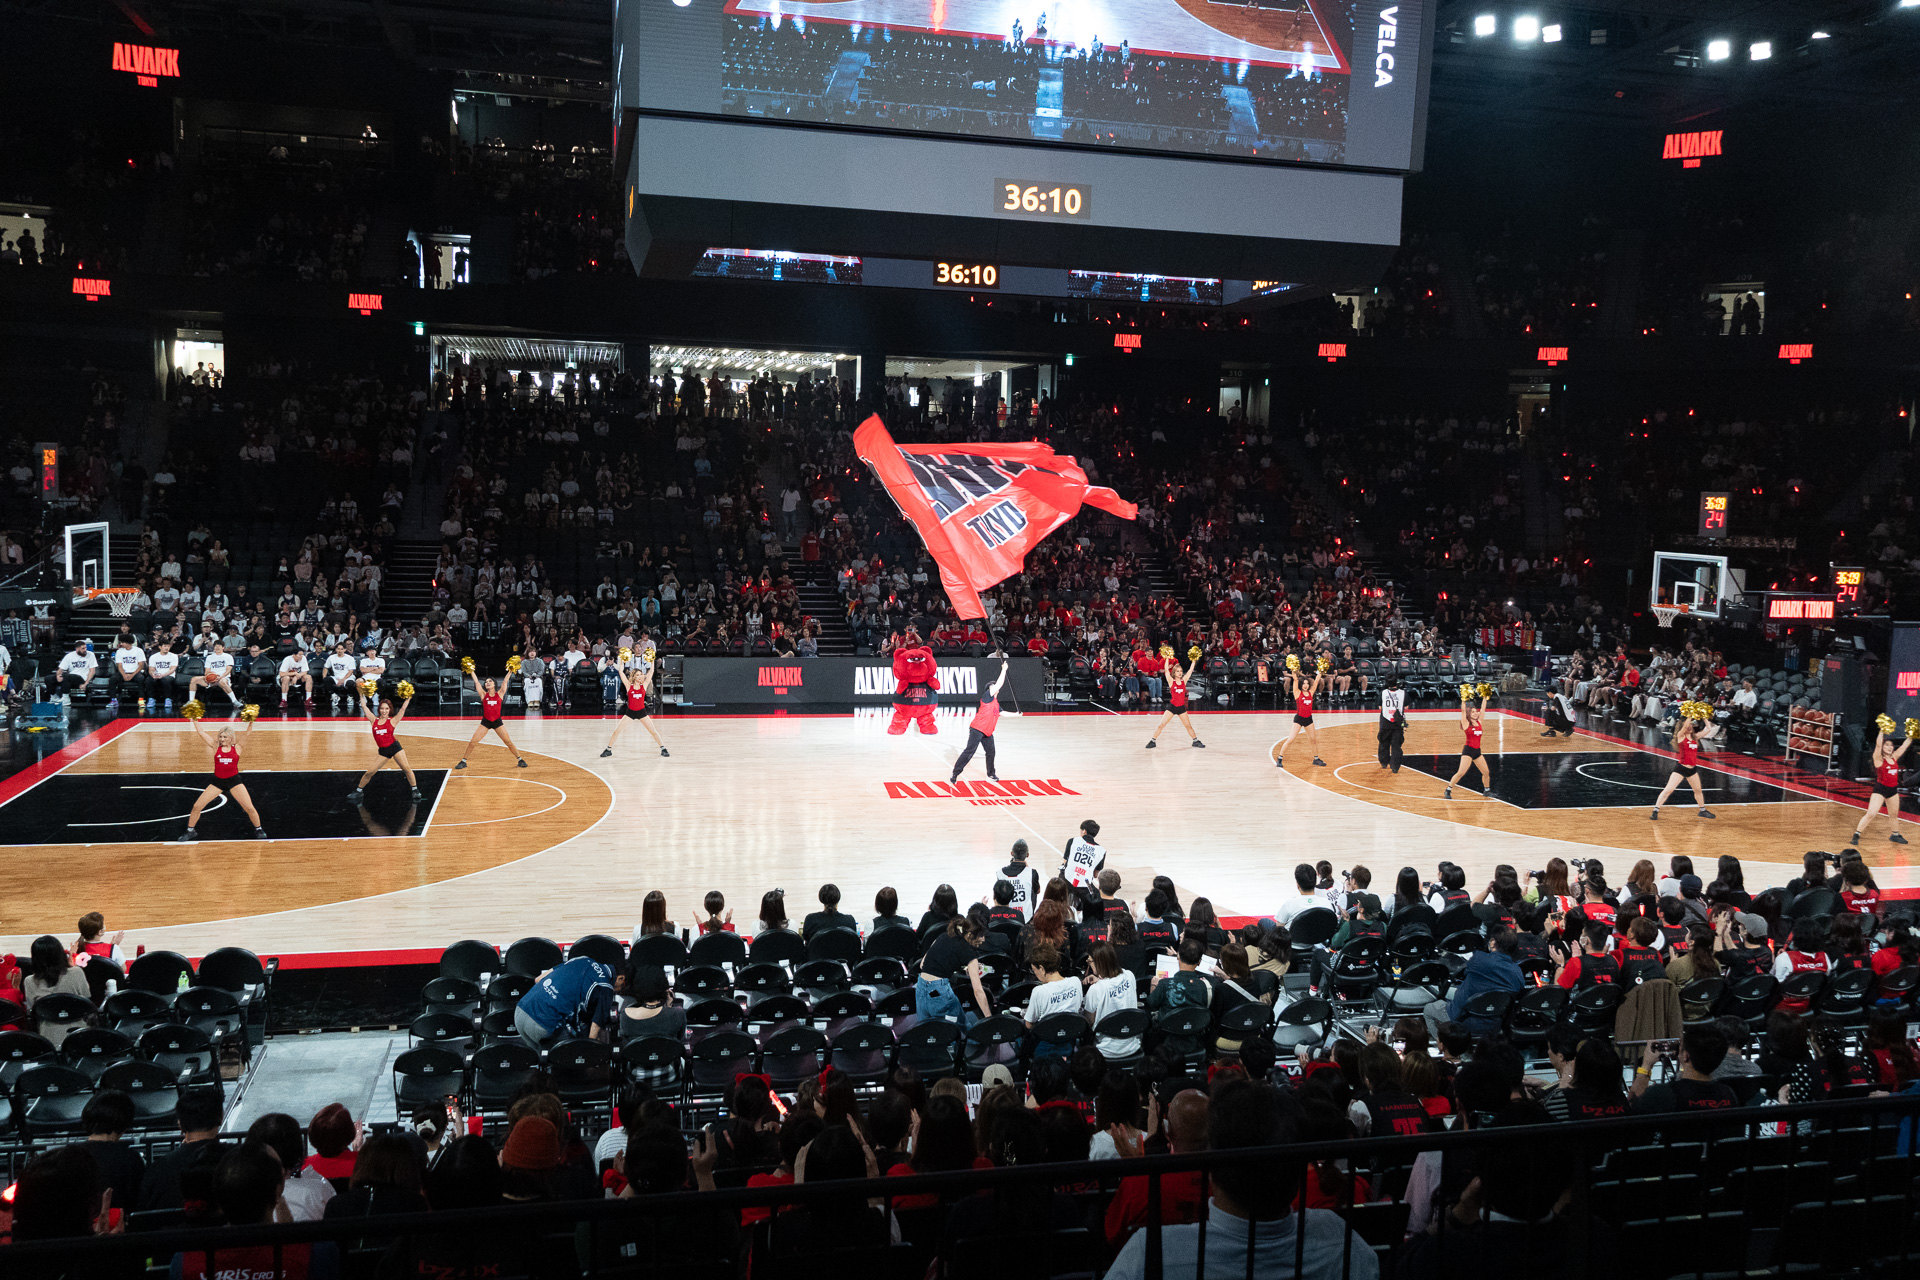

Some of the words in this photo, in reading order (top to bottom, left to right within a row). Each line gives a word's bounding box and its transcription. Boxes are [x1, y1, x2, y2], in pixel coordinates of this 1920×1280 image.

[1374, 6, 1398, 87] VELCA
[112, 42, 180, 77] ALVARK
[137, 75, 158, 88] TOKYO
[1662, 130, 1723, 159] ALVARK
[1003, 183, 1082, 215] 36:10
[936, 262, 997, 286] 36:10
[72, 278, 111, 296] ALVARK
[348, 293, 382, 310] ALVARK
[1114, 333, 1142, 348] ALVARK
[1318, 344, 1347, 357] ALVARK
[1537, 347, 1568, 360] ALVARK
[1778, 344, 1813, 358] ALVARK
[1706, 510, 1724, 529] 24
[1836, 585, 1858, 602] 24
[1769, 600, 1804, 618] ALVARK
[1804, 600, 1834, 618] TOKYO
[758, 666, 803, 686] ALVARK
[854, 666, 898, 694] ALVA
[934, 666, 978, 694] OKYO
[1896, 672, 1920, 690] ALVA
[883, 779, 1083, 799] ALVARK
[1074, 852, 1093, 868] 024
[1012, 890, 1026, 902] 23
[1050, 995, 1061, 1004] WE
[1062, 989, 1078, 1001] RISE
